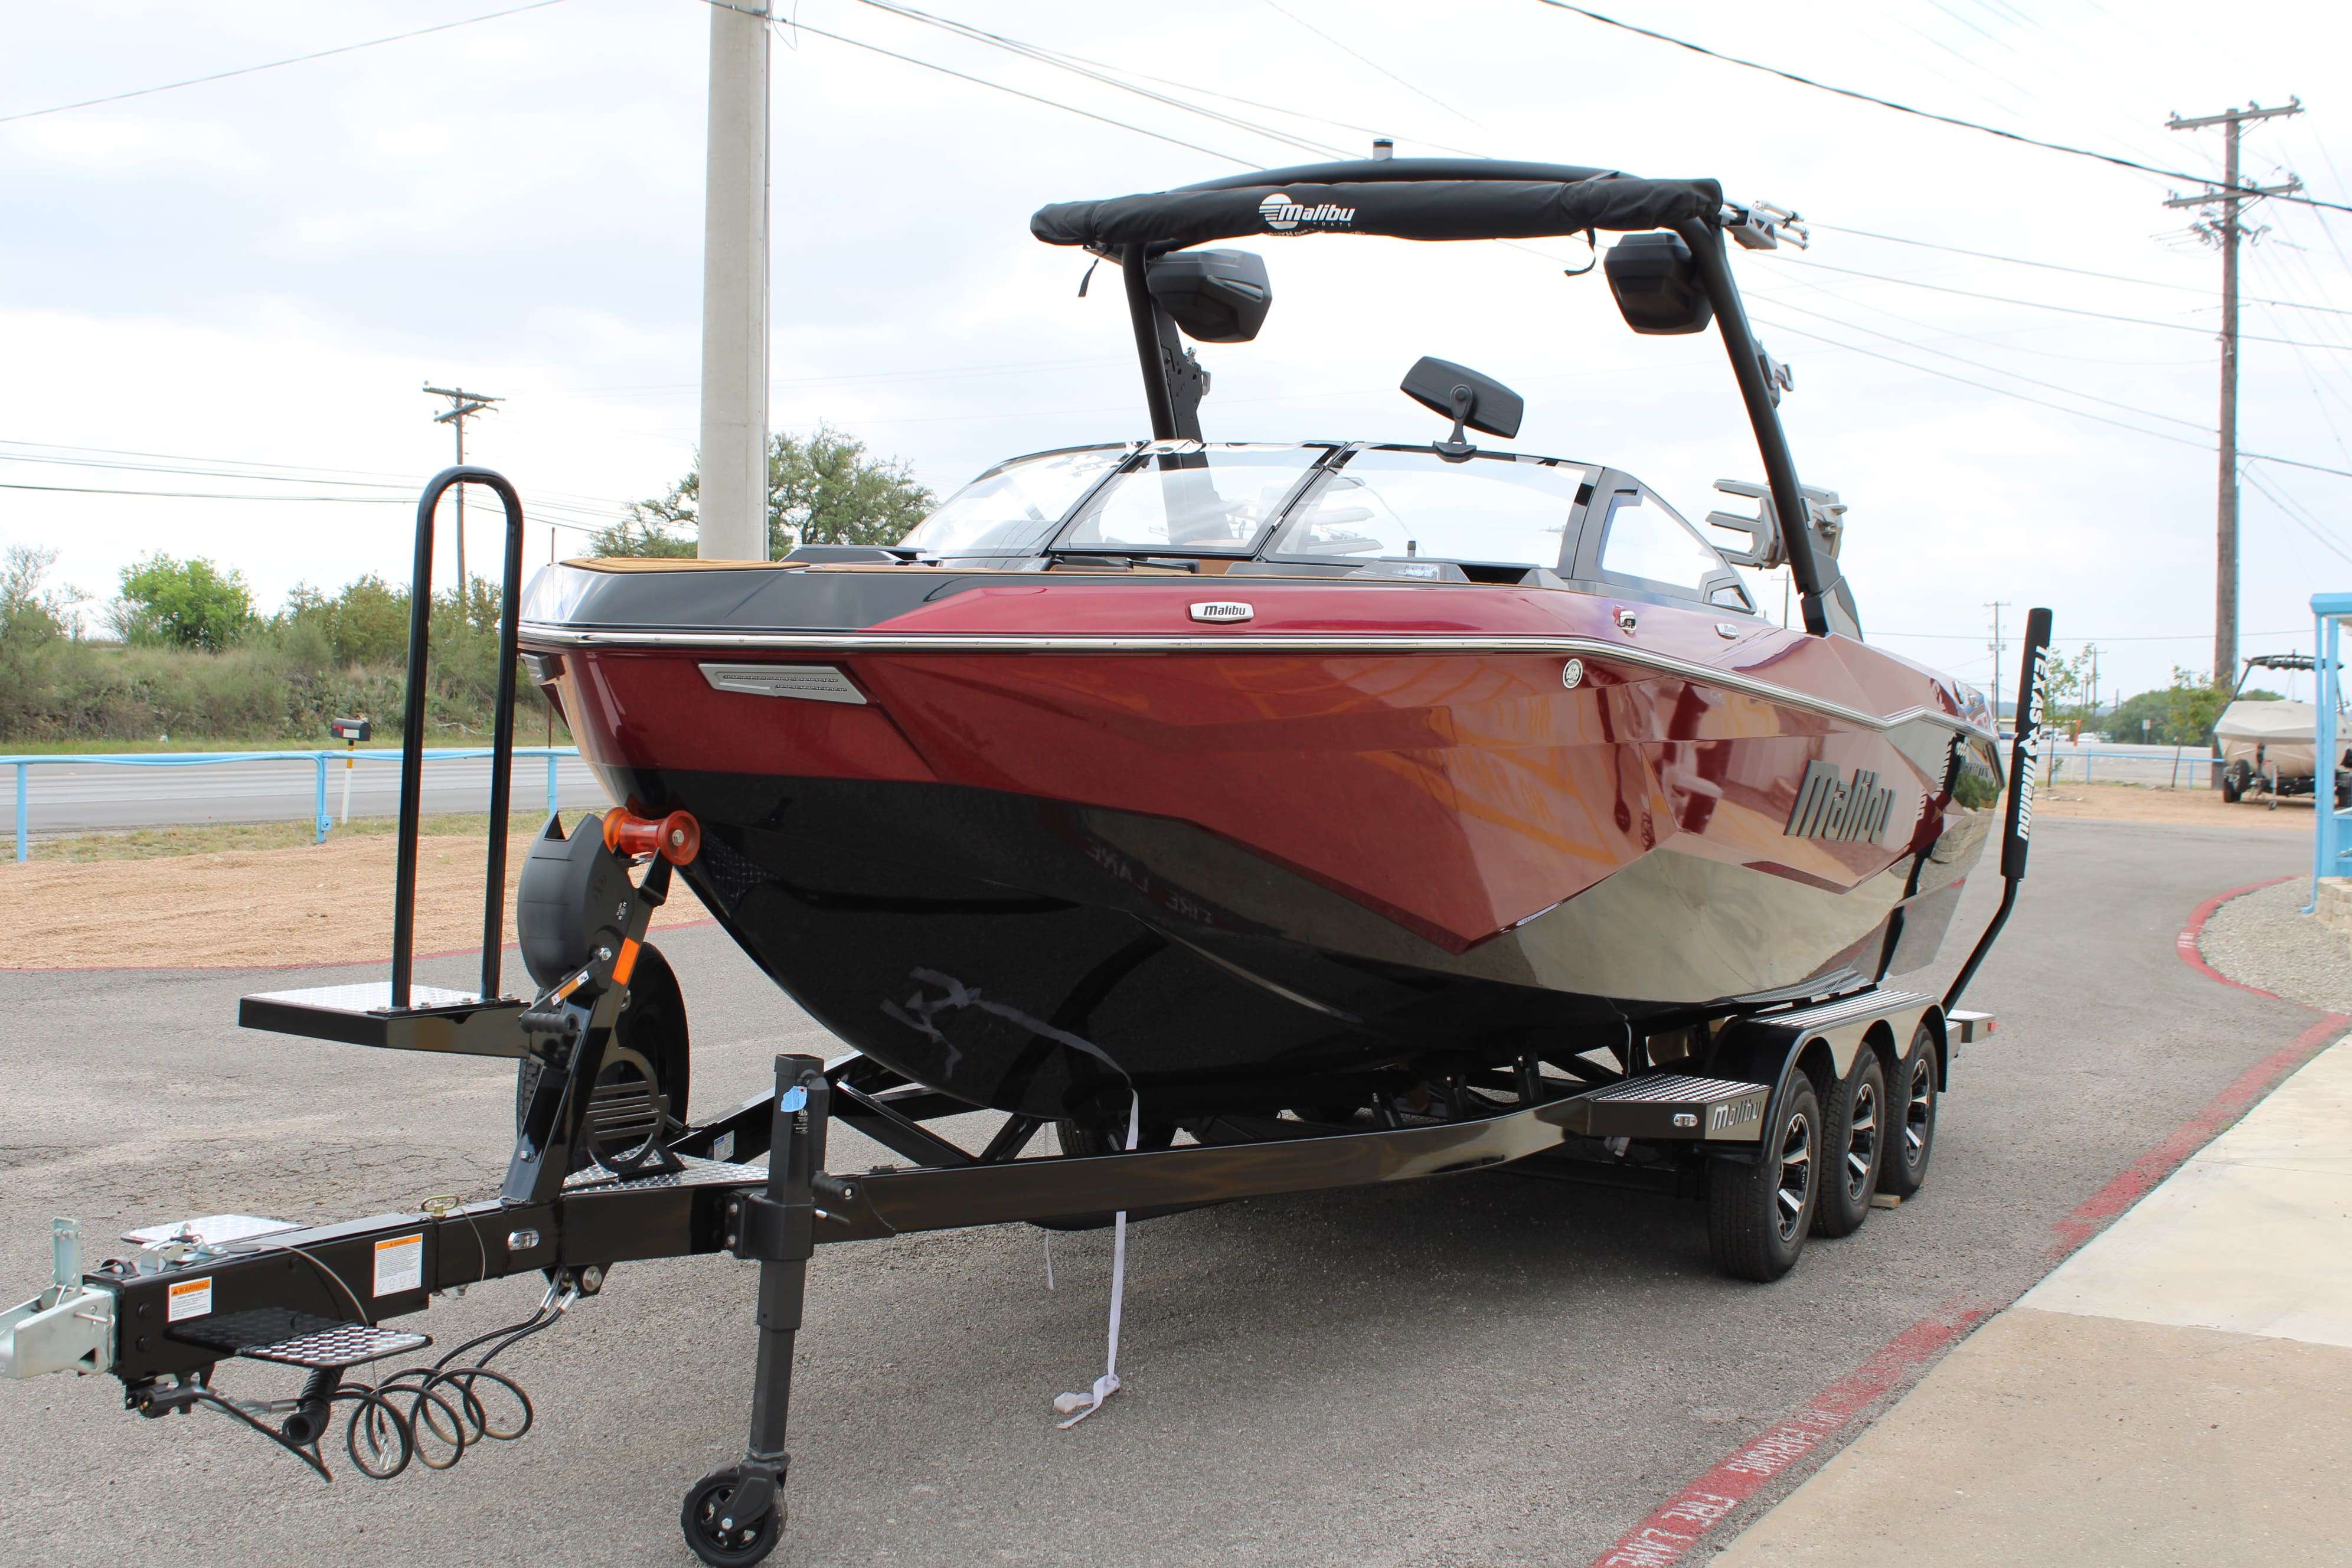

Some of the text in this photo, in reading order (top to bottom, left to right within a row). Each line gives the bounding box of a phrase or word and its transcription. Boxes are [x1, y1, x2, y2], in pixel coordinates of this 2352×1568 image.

[1278, 204, 1355, 221] Malibu
[1203, 605, 1246, 616] Malibu
[2028, 645, 2050, 725] TEXAS
[1782, 759, 1897, 845] Malibu
[1711, 1099, 1762, 1131] Malibu
[1720, 1426, 1824, 1476] PARKING
[1661, 1491, 1737, 1527] FIRE
